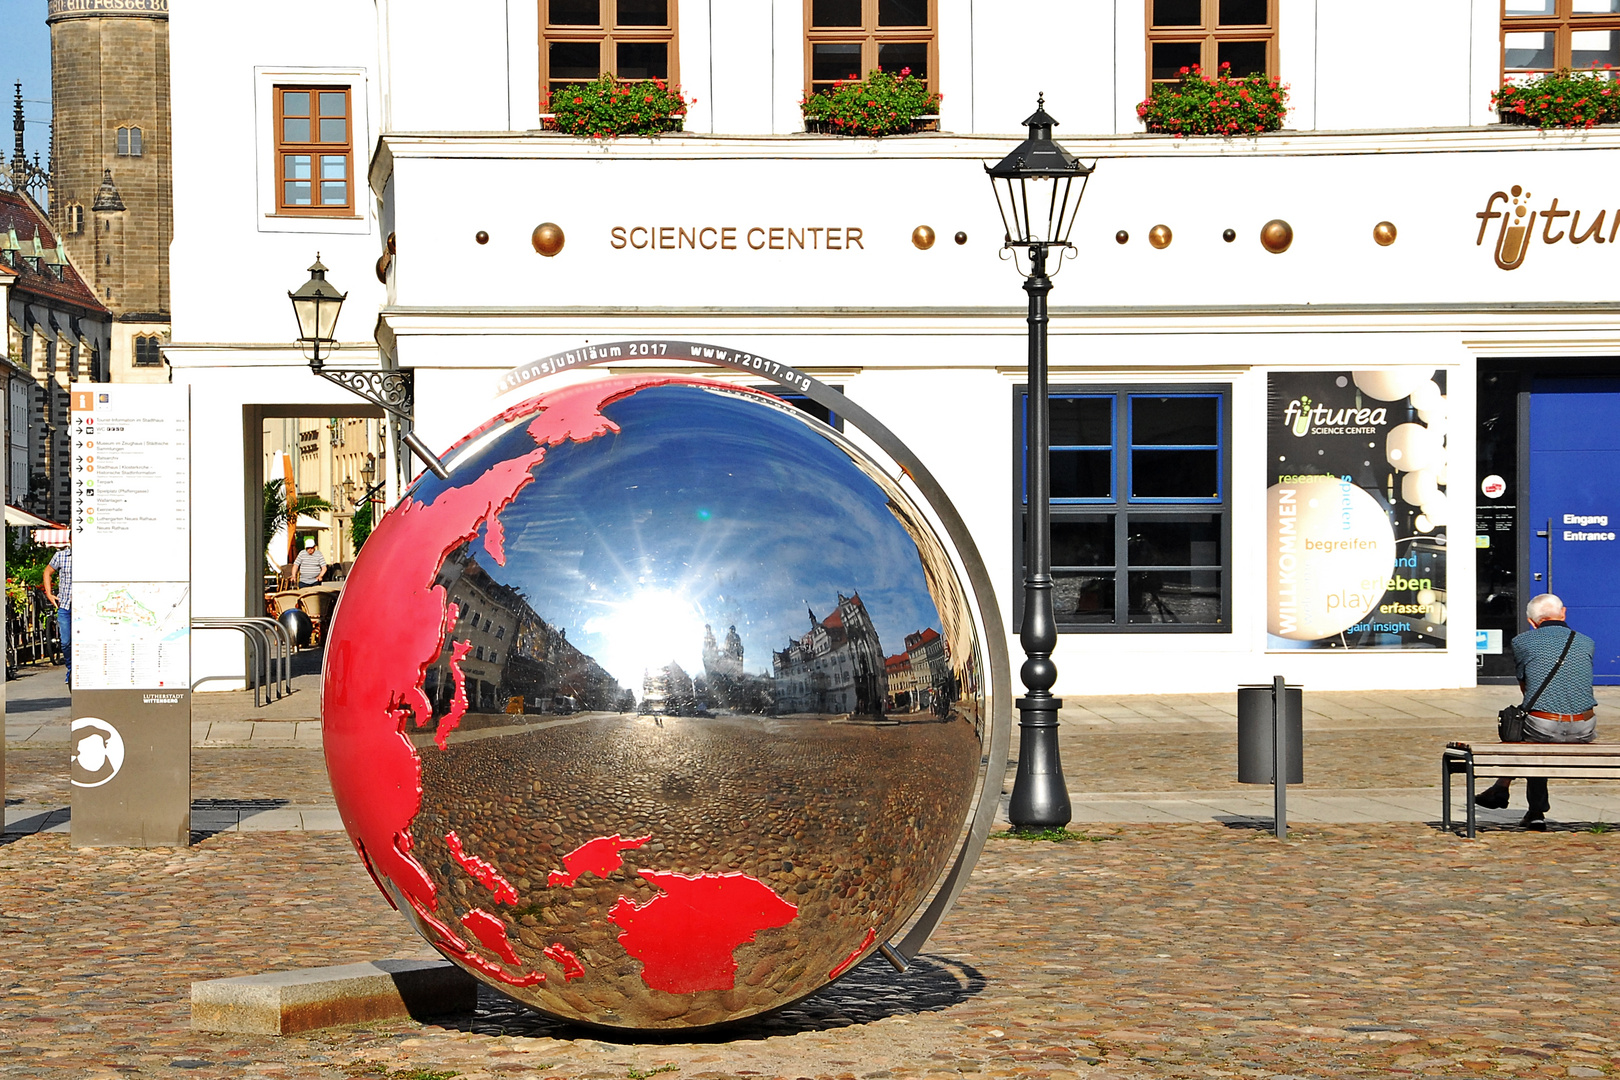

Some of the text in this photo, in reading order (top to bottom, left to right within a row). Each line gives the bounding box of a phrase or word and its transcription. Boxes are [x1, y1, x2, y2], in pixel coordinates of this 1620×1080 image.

[610, 226, 864, 250] SCIENCE CENTER
[629, 343, 668, 356] 2017
[690, 345, 811, 391] www.r2017.org
[1284, 397, 1387, 438] futurea
[1311, 426, 1376, 435] SCIENCE CENTER
[1279, 473, 1335, 484] research
[1339, 475, 1353, 530] spielen
[1563, 514, 1608, 526] Eingang
[1563, 531, 1616, 541] Entrance
[1305, 538, 1377, 553] begreifen
[1279, 489, 1297, 635] WILLKOMMEN
[1360, 576, 1432, 591] erleben
[1326, 590, 1375, 613] play
[1380, 602, 1435, 614] erfassen
[1373, 622, 1411, 634] insight
